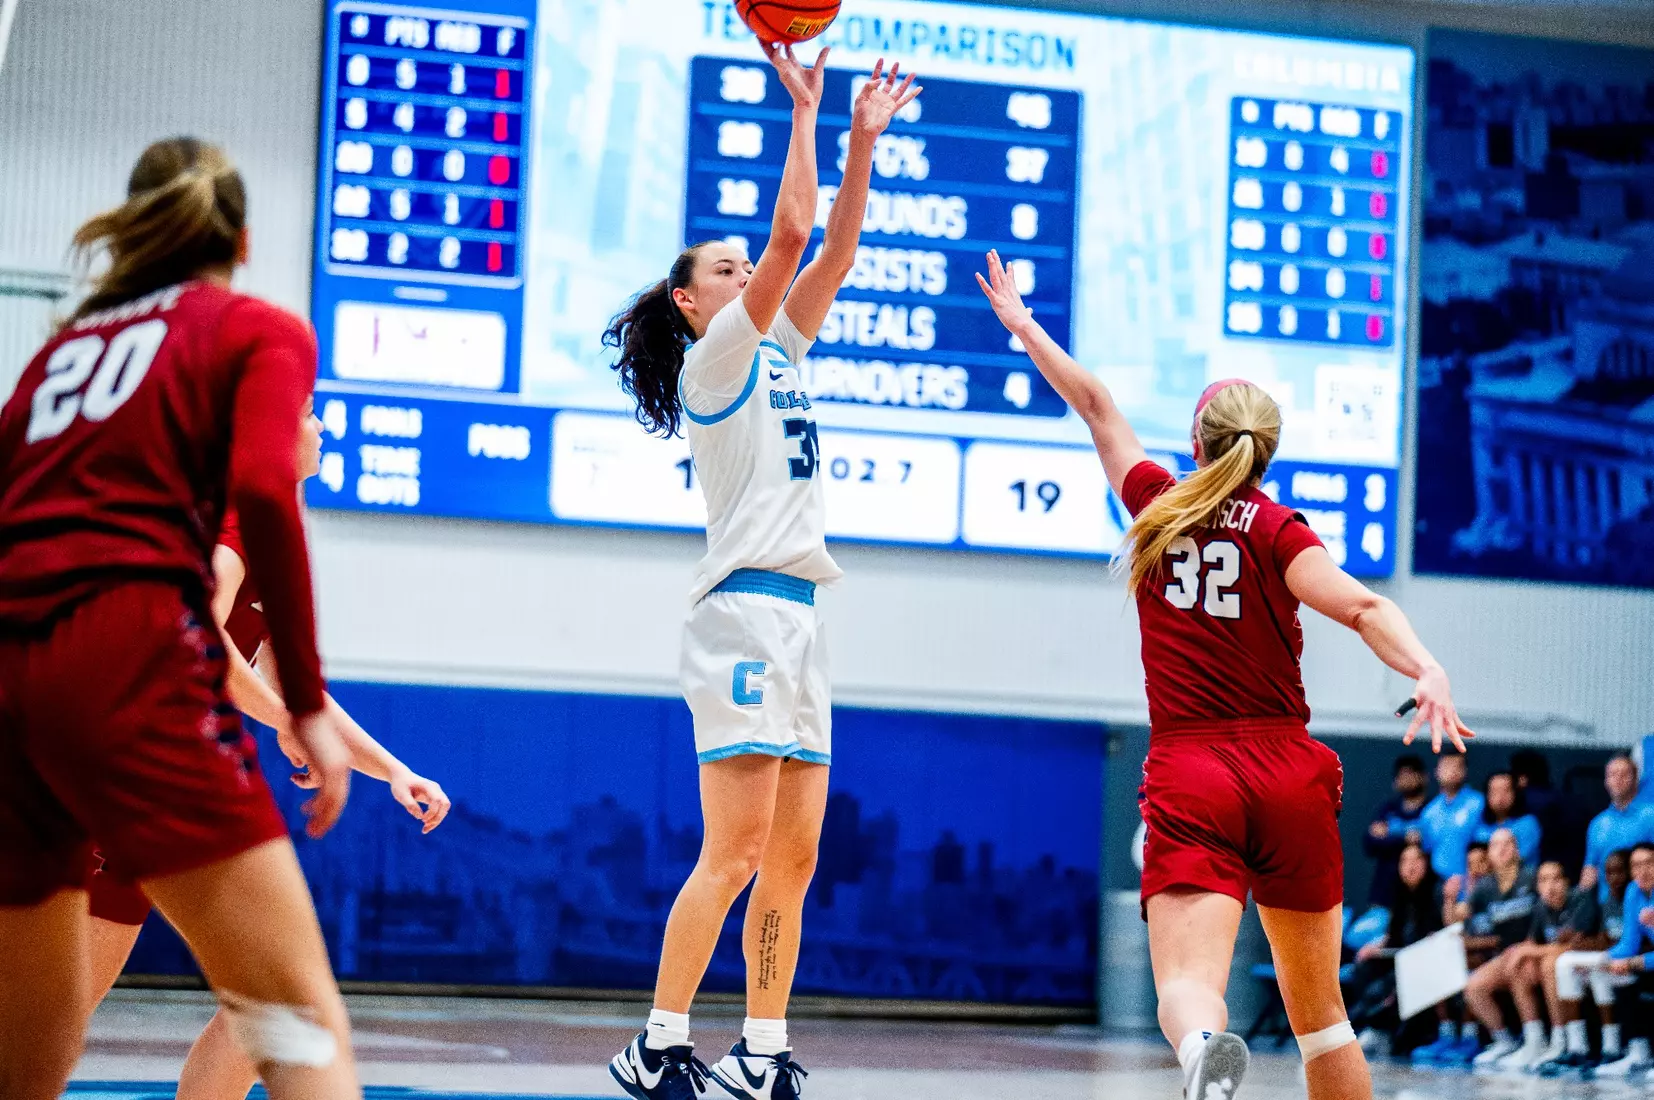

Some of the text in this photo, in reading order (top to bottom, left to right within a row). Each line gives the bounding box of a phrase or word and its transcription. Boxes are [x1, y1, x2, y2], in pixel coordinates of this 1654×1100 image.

[26, 317, 168, 445] 20
[798, 356, 969, 410] URNOVERS
[1009, 480, 1061, 513] 19
[1164, 535, 1242, 619] 32
[731, 660, 766, 706] C
